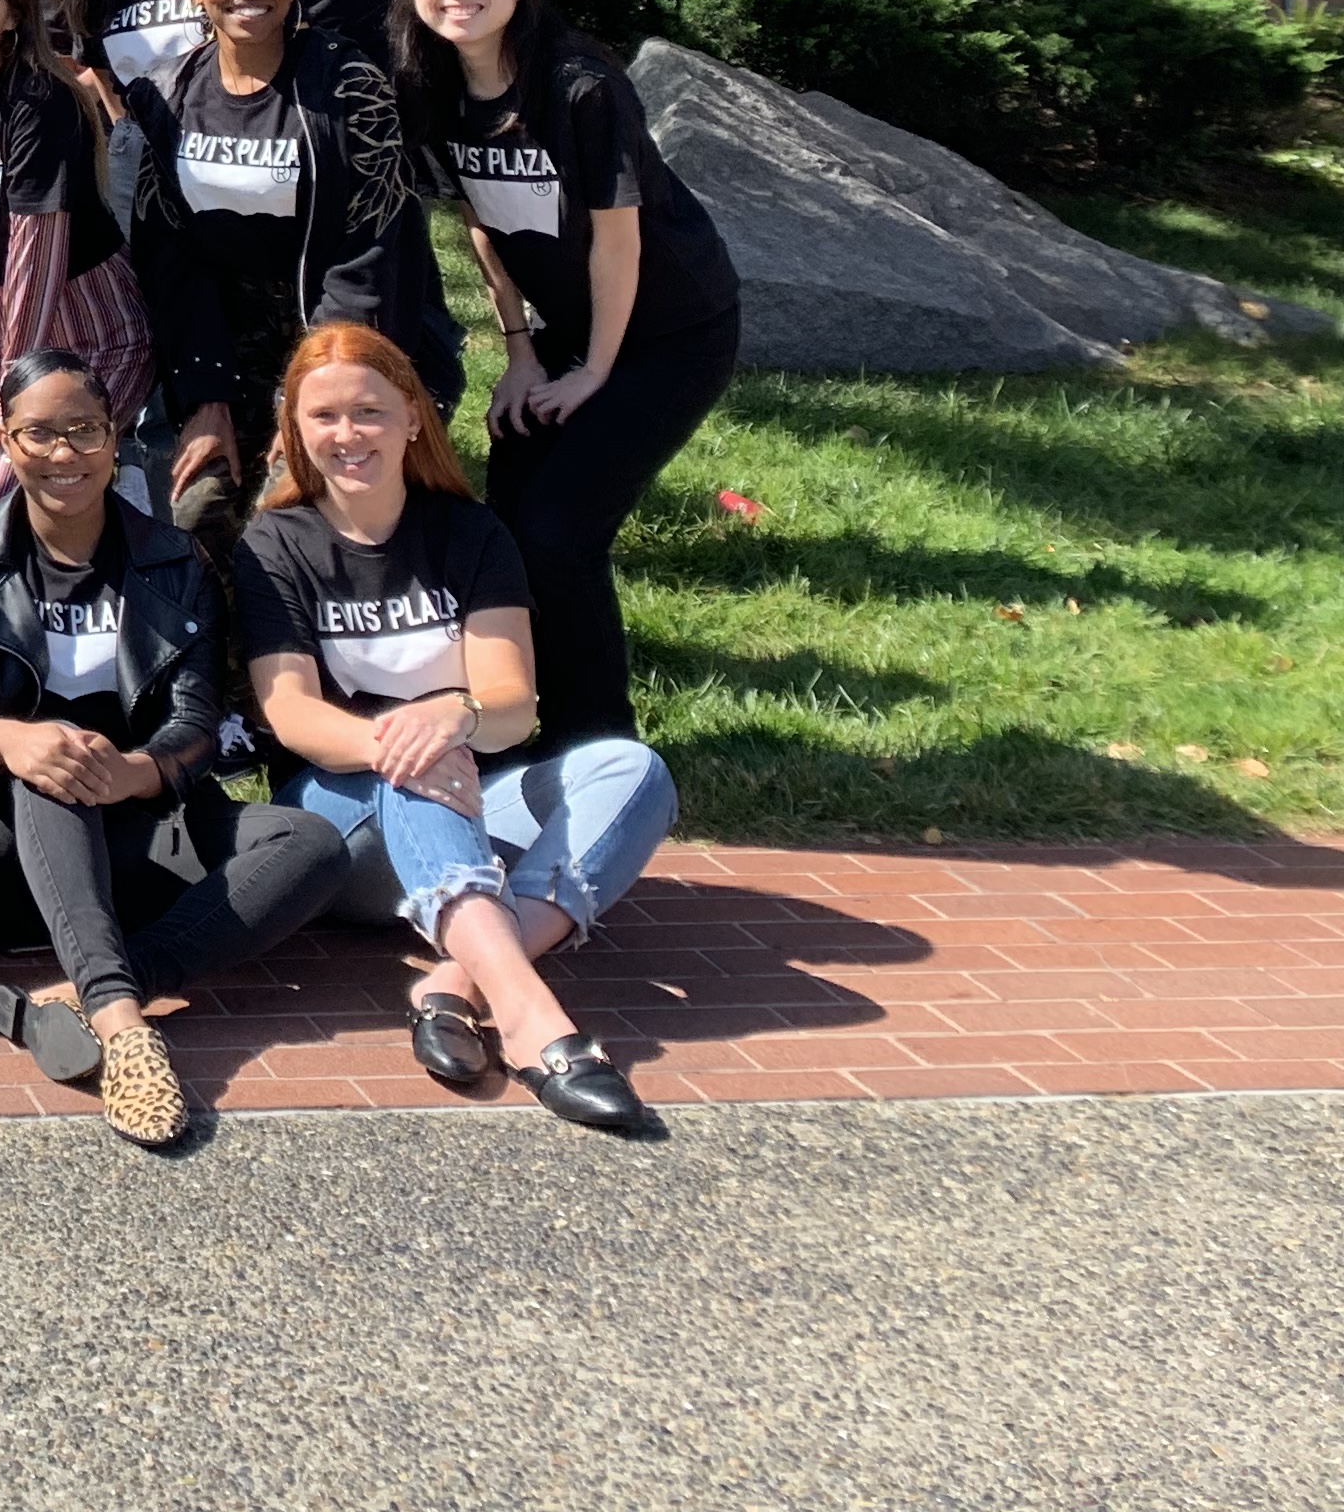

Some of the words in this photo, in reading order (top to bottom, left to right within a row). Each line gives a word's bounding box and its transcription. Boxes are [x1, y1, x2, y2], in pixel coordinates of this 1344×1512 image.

[236, 137, 301, 168] PLAZA
[487, 147, 558, 176] PLAZA
[70, 600, 117, 635] PLA
